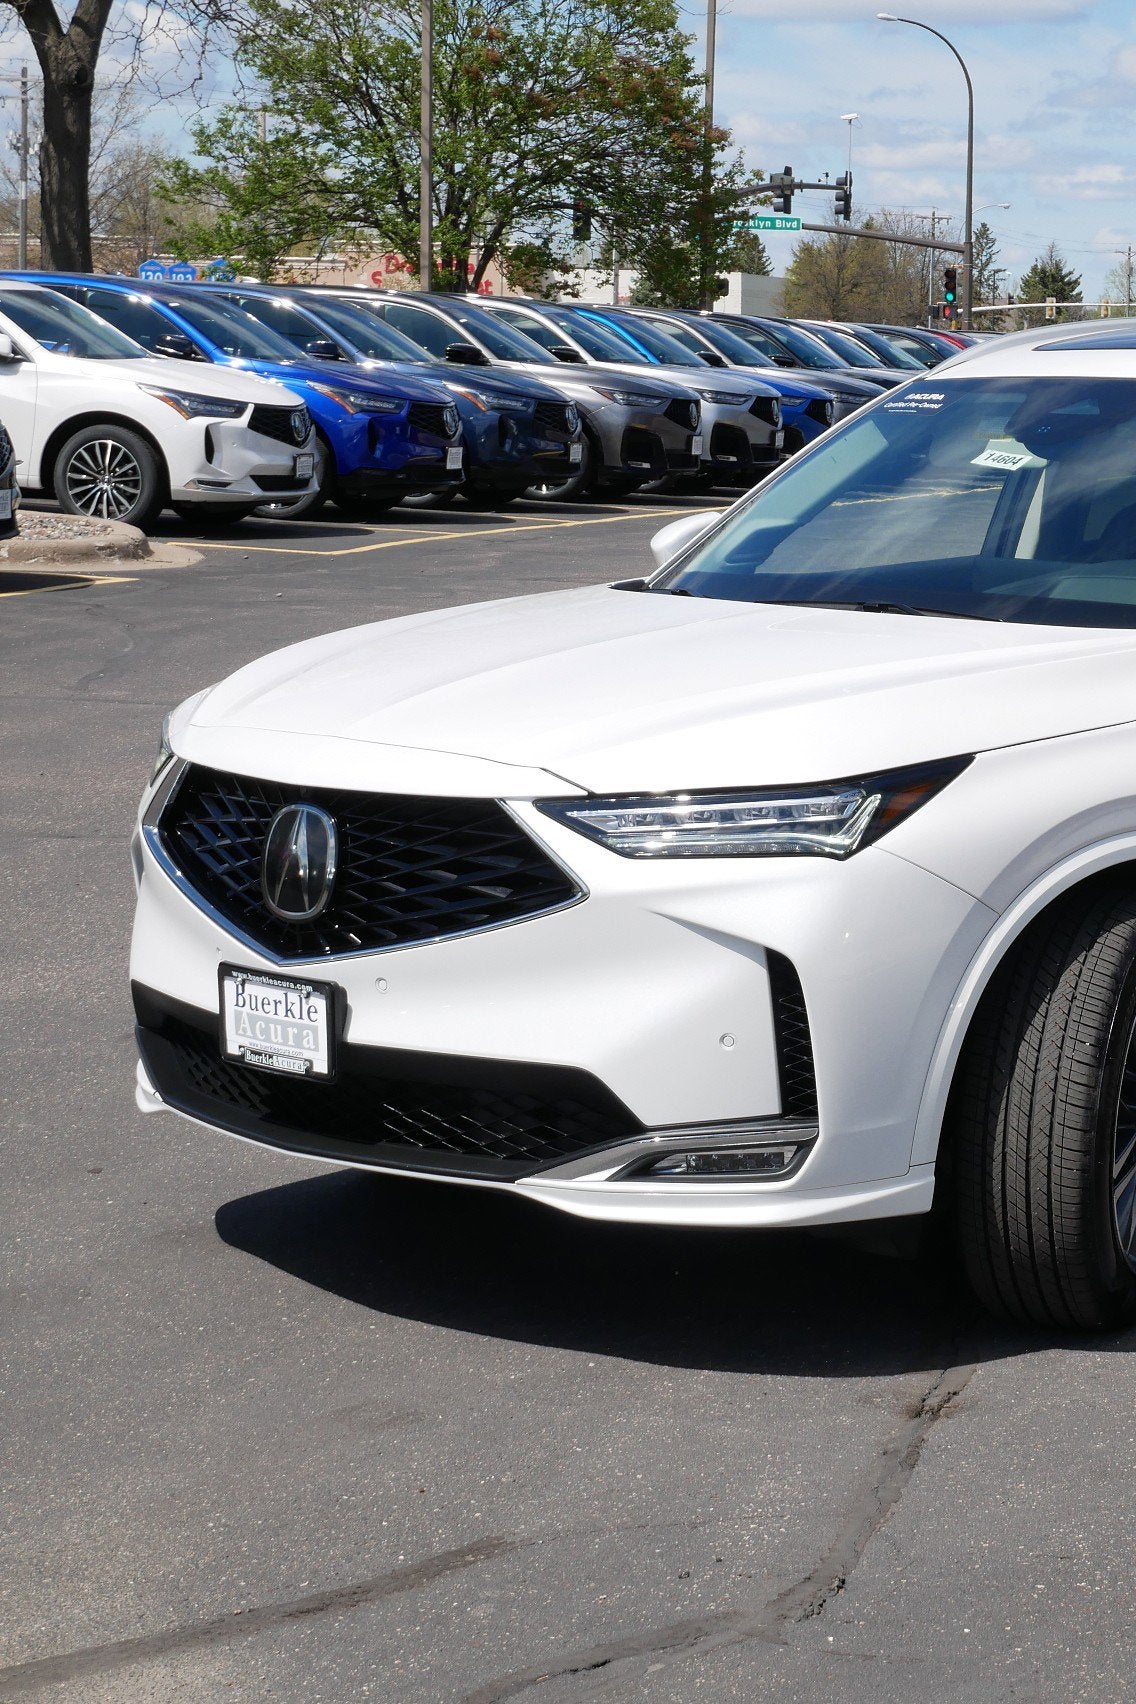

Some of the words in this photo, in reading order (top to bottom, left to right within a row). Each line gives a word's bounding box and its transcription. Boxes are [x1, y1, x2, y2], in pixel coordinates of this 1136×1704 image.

[732, 219, 771, 229] roklyn
[776, 219, 798, 228] Blvd
[984, 452, 1024, 465] 14604
[232, 970, 313, 992] www.buerkleacura.com
[234, 982, 319, 1023] Buerkle
[238, 1011, 316, 1050] Acura
